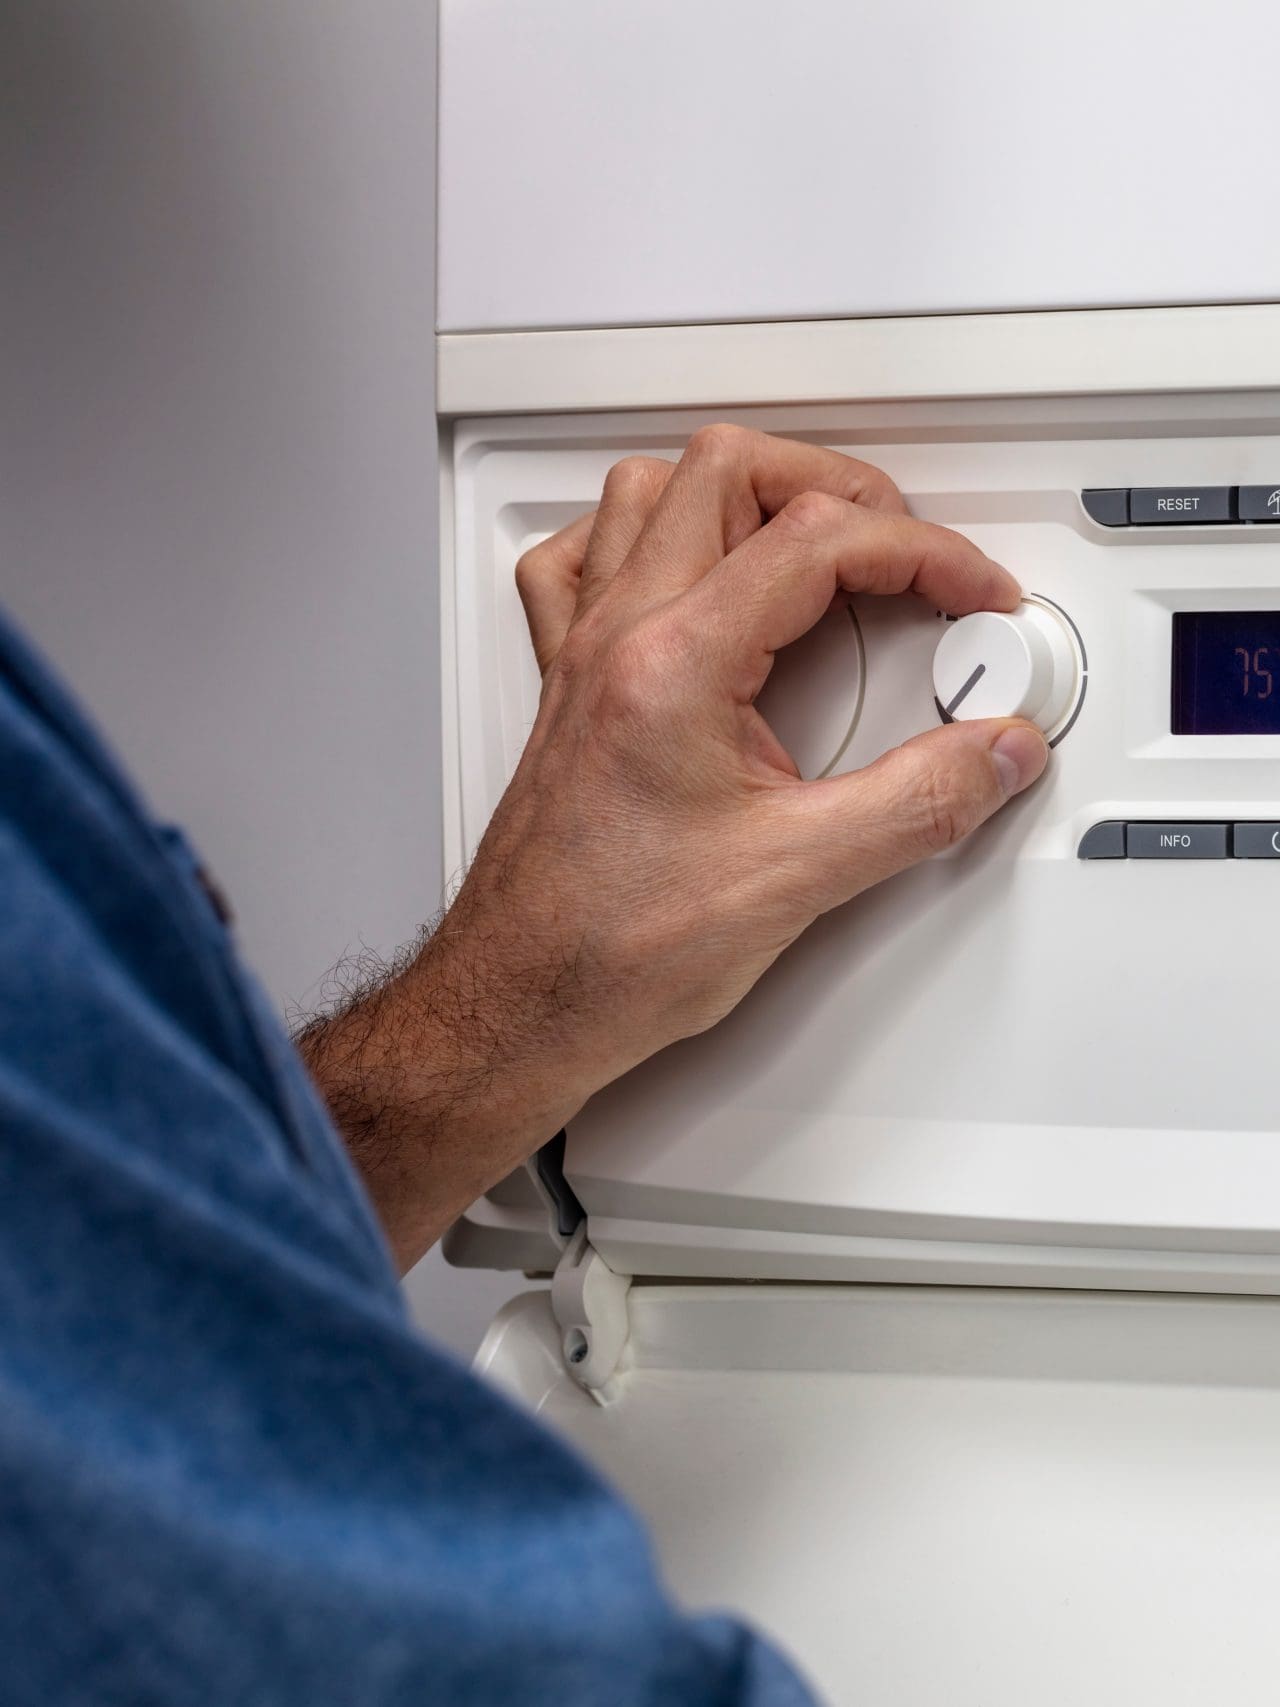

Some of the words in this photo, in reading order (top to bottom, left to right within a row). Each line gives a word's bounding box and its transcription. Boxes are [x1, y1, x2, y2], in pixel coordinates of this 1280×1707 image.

[1157, 498, 1199, 511] RESET
[1235, 647, 1273, 698] 75
[1160, 835, 1191, 847] INFO
